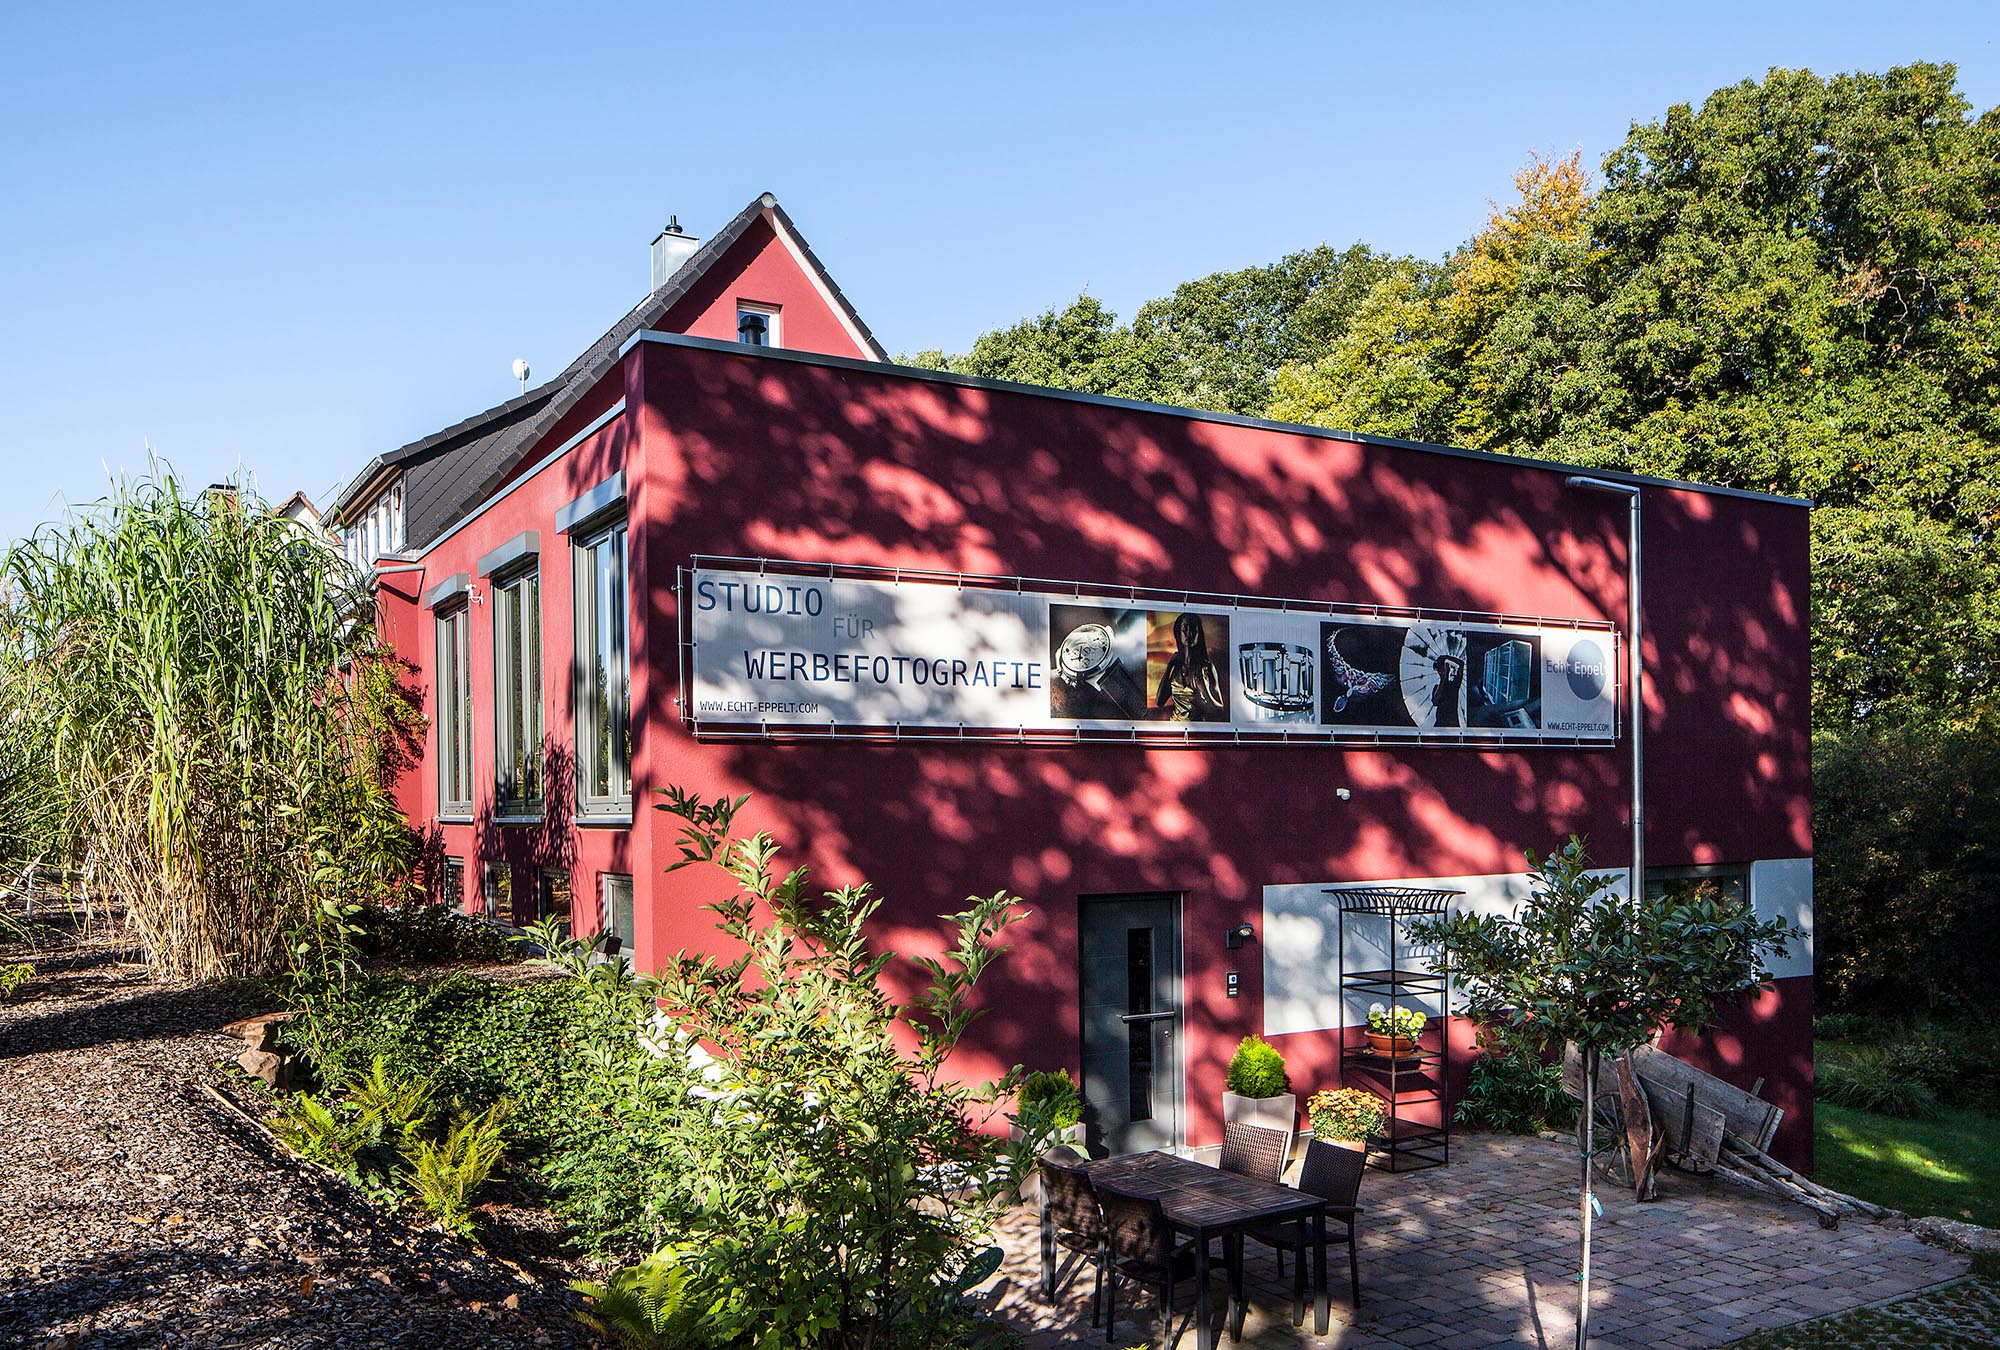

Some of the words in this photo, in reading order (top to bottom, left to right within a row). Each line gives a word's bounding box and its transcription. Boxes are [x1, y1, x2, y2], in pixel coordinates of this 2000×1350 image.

[697, 581, 823, 617] STUDIO
[833, 614, 875, 639] FÜR
[744, 650, 1042, 689] WERBEFOTOGRAFIE
[1546, 660, 1571, 674] Echt
[699, 700, 819, 714] WWW.ECHT-EPPELT.COM
[1547, 722, 1609, 731] WWW.ECHT-EPPELT.COM
